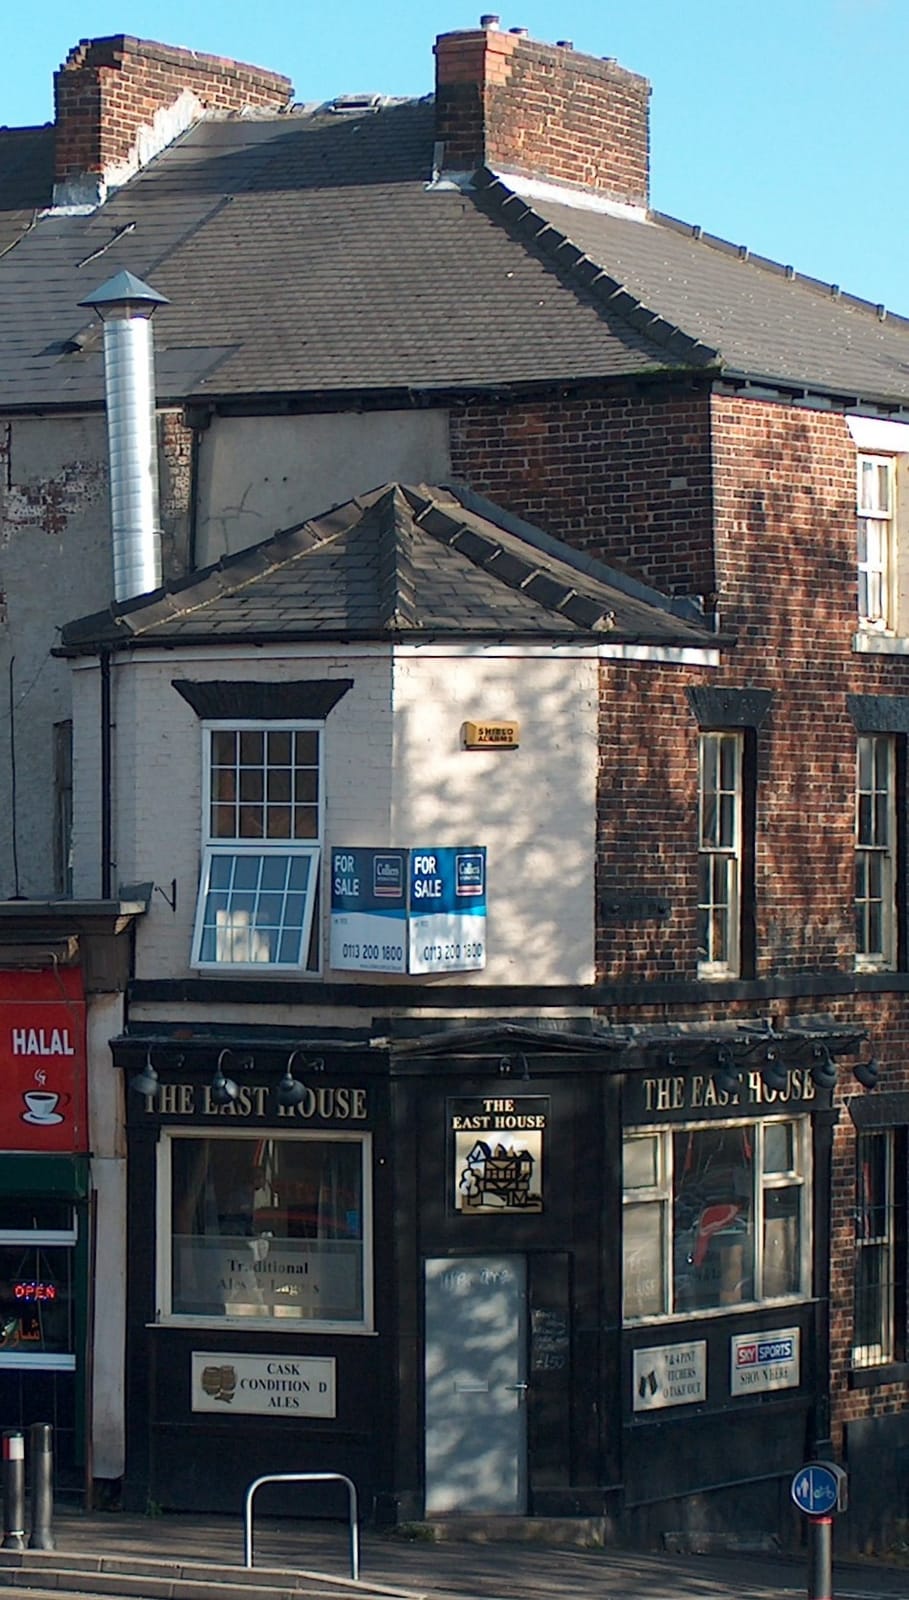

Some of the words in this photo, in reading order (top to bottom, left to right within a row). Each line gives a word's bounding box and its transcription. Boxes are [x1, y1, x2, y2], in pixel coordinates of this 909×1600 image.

[334, 855, 355, 873] FOR
[414, 856, 436, 875] FOR
[334, 878, 360, 896] SALE
[414, 879, 442, 898] SALE
[342, 943, 360, 958] 0113
[362, 944, 379, 960] 200
[382, 945, 403, 961] 1800
[423, 945, 442, 961] 0113
[444, 944, 461, 961] 200
[12, 1028, 75, 1056] HALAL
[145, 1085, 194, 1114] THE
[643, 1077, 684, 1110] THE
[483, 1100, 514, 1112] THE
[453, 1117, 490, 1129] EAST
[495, 1115, 545, 1128] HOUSE
[228, 1259, 309, 1274] Trditional
[14, 1285, 56, 1299] OPEN
[739, 1348, 755, 1361] SKY
[759, 1343, 791, 1359] SPORTS
[267, 1363, 300, 1375] CASK
[664, 1368, 696, 1381] ITCHERS
[240, 1379, 327, 1393] CONDITIOND
[268, 1397, 300, 1408] ALES
